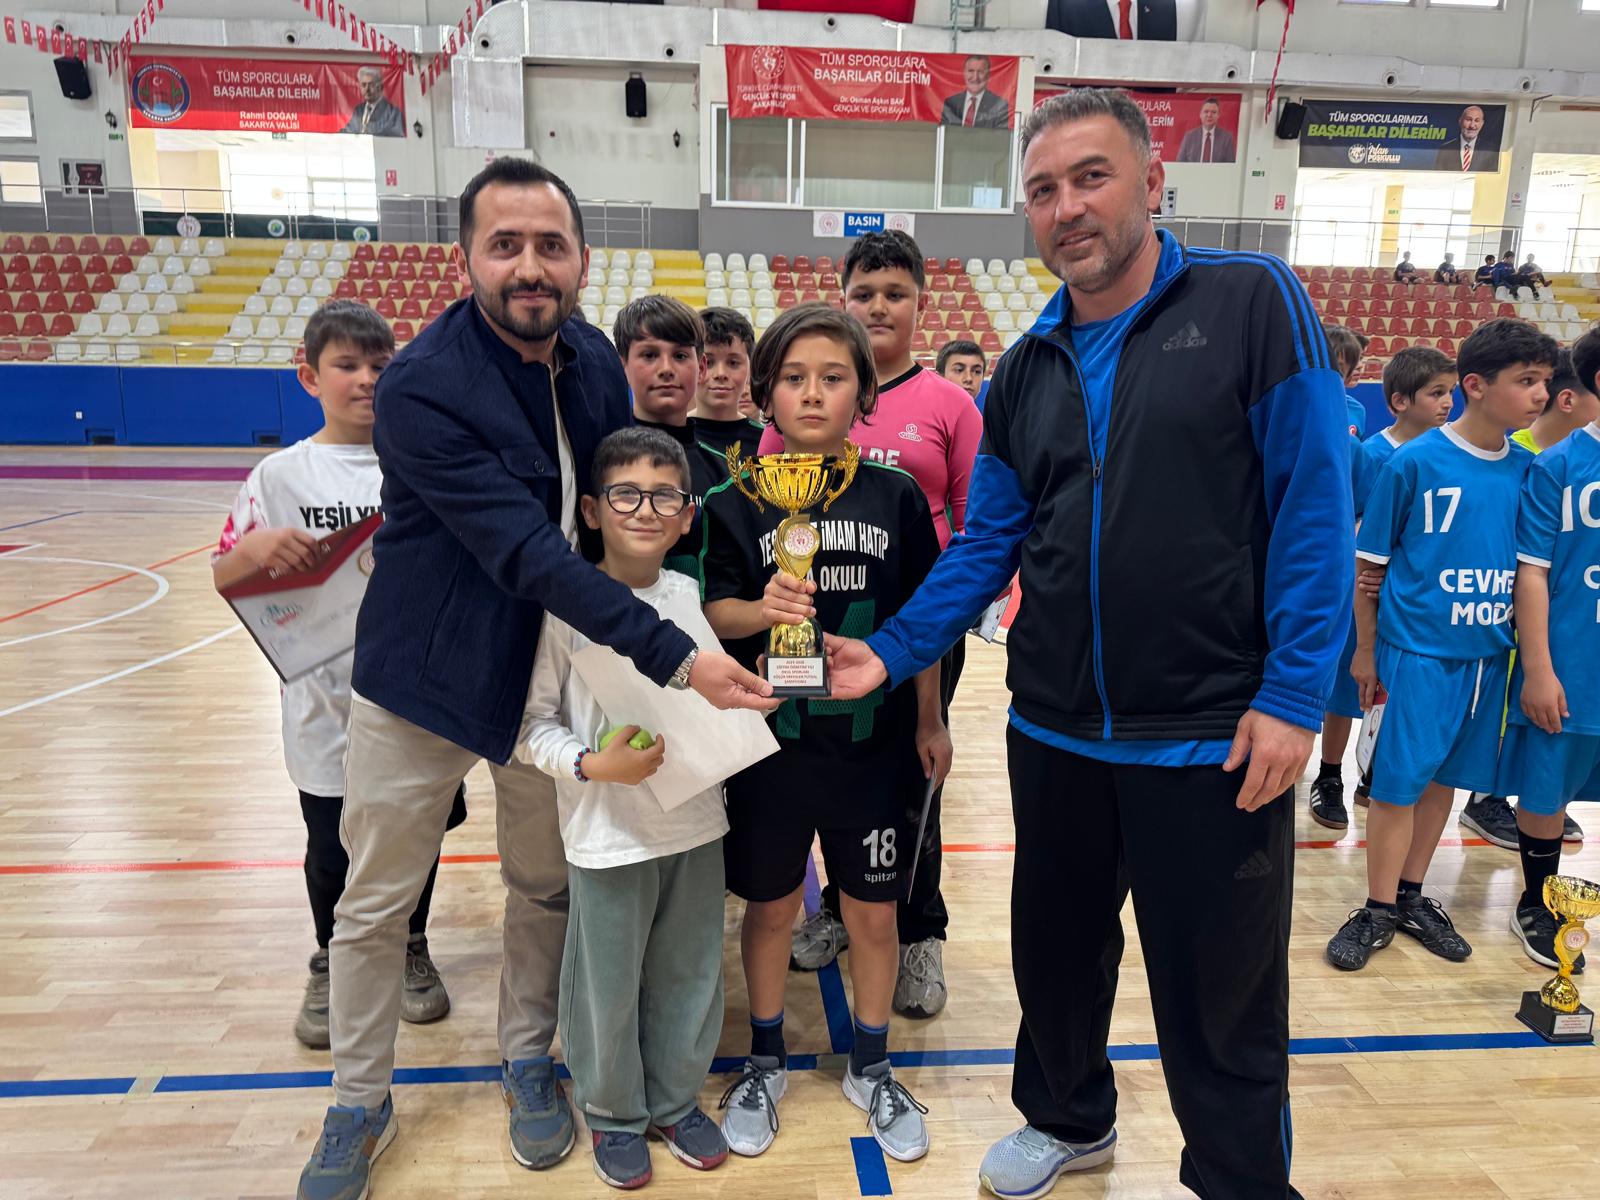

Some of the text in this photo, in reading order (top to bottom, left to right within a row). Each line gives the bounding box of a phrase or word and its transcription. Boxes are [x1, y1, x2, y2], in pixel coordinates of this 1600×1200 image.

[820, 52, 927, 69] TÜM SPORCULARA
[216, 69, 315, 85] TÜM SPORCULARA
[814, 69, 931, 86] BAŞARILAR DİLERİM
[213, 86, 320, 100] BAŞARILAR DİLERİM
[1136, 100, 1172, 111] CULARA
[240, 111, 298, 121] Rahmi DOĞAN
[1329, 111, 1428, 124] TÜM SPORCULARIMIZA
[239, 120, 300, 130] SAKARYA VALİSİ
[1307, 124, 1447, 140] BAŞARILAR DİLERİM
[847, 215, 881, 226] BASIN
[1423, 486, 1462, 533] 17
[820, 565, 867, 592] OKULU
[1438, 568, 1516, 596] CEVHE
[862, 827, 897, 868] 18
